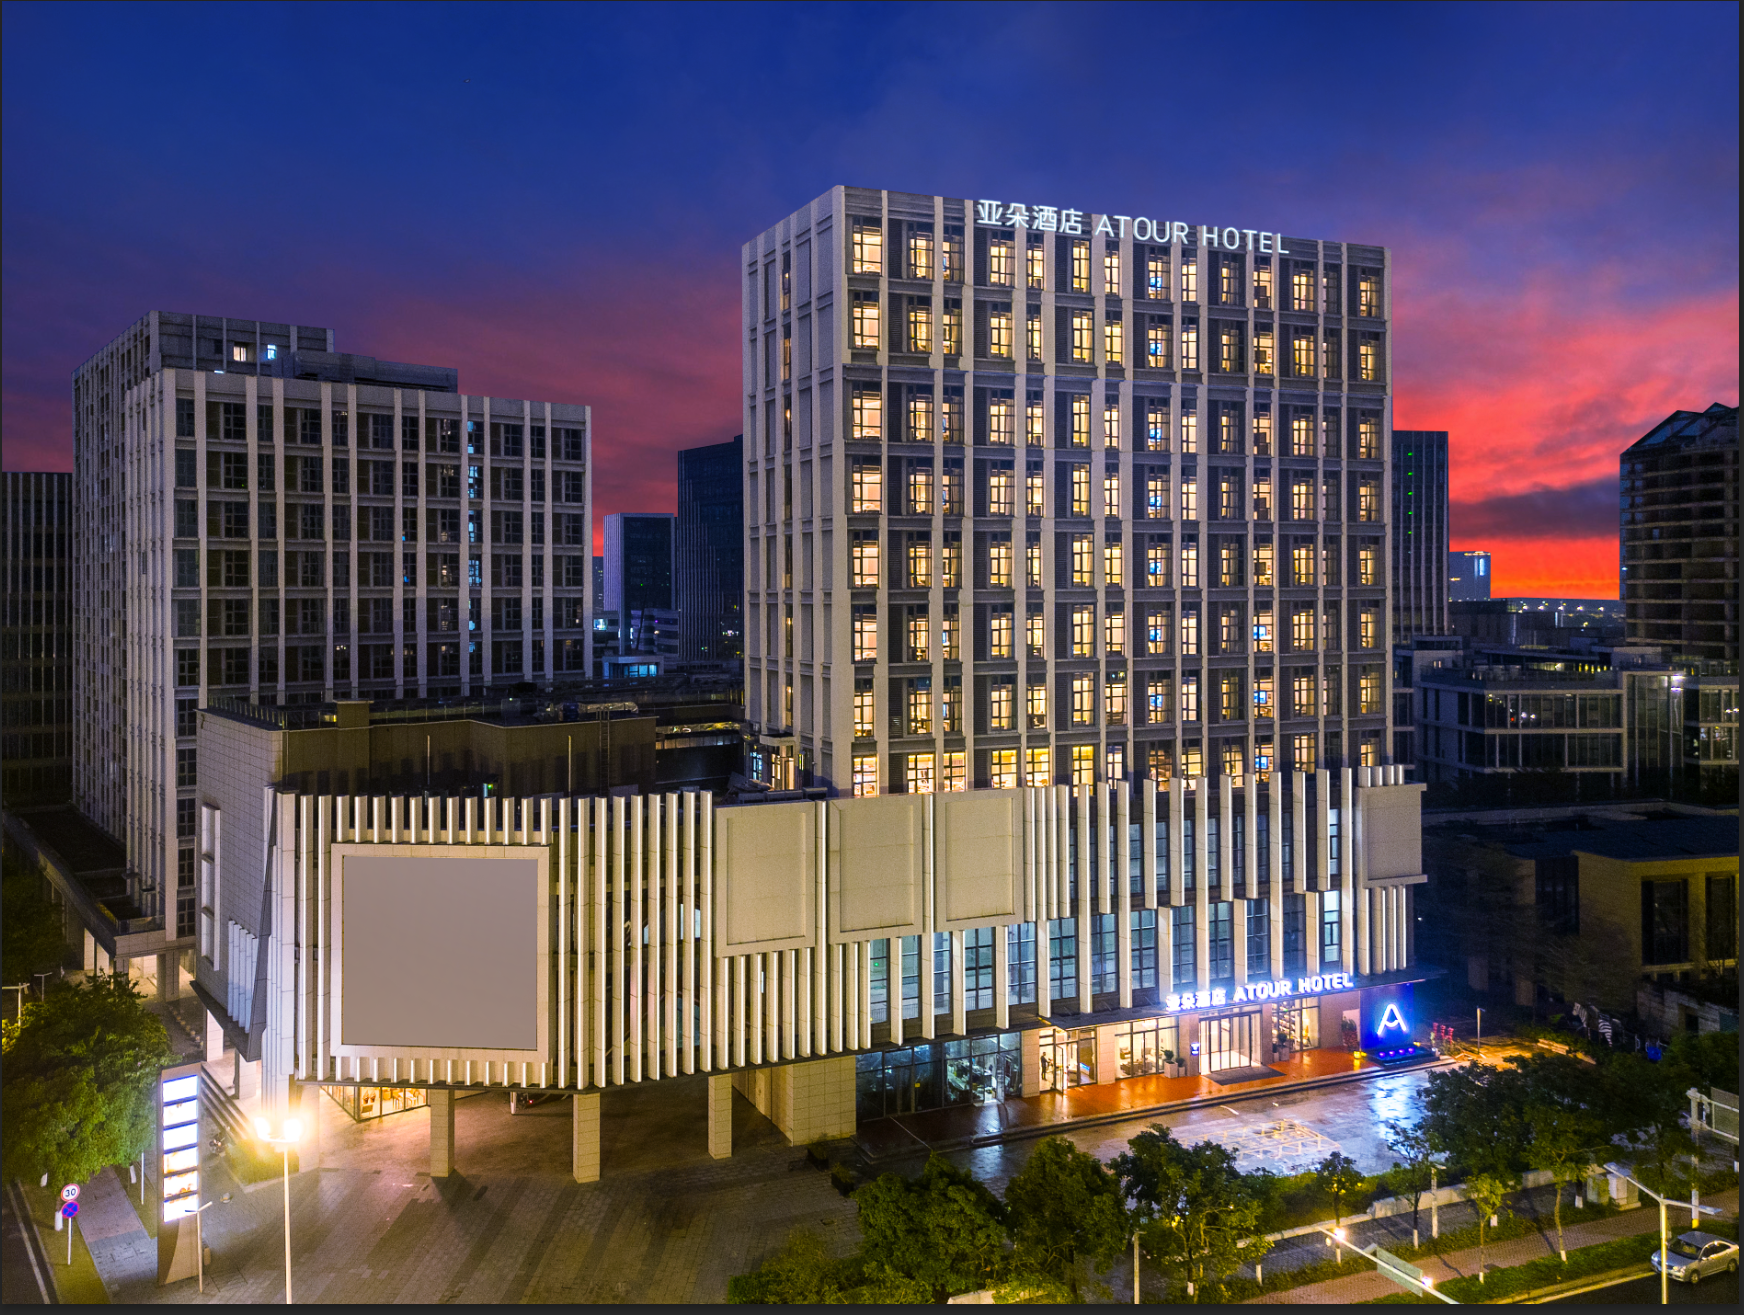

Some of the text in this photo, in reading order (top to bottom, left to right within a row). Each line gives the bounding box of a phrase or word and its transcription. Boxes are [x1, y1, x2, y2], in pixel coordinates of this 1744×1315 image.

[977, 200, 1289, 254] 亚朵酒店 ATOUR HOTEL
[1233, 981, 1292, 1002] ATOUR
[1298, 972, 1354, 993] HOTEL
[65, 1188, 76, 1197] 30
